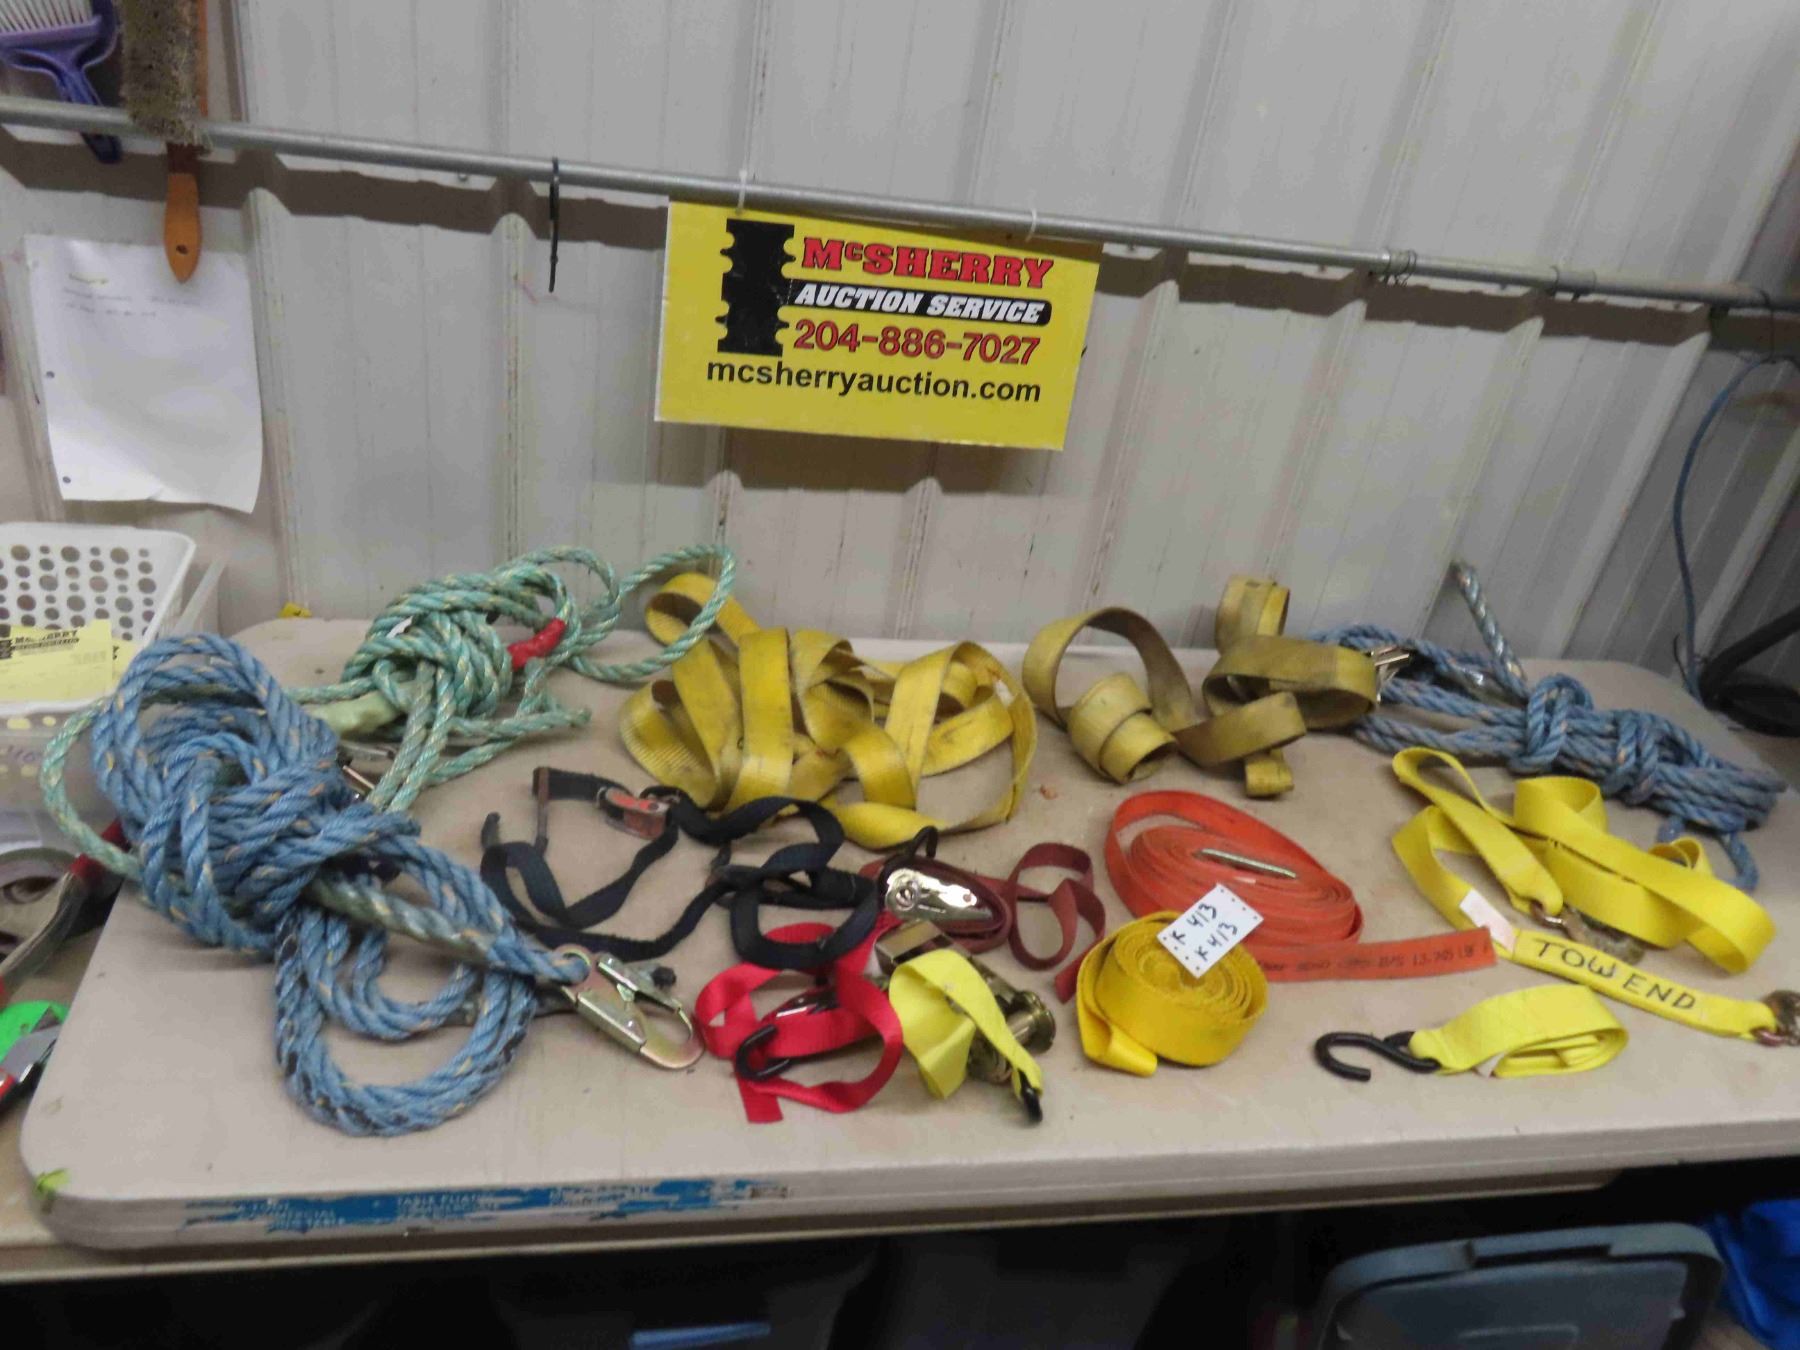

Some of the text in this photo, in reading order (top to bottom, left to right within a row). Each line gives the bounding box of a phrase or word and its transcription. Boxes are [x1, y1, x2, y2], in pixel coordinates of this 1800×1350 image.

[795, 284, 1045, 323] AUCTION SERVICE
[794, 320, 1040, 364] 204-886-7027
[707, 362, 1041, 401] mcsherryauction.com
[1186, 903, 1217, 928] 413
[1207, 922, 1238, 947] 413
[1533, 939, 1696, 1010] TOW END
